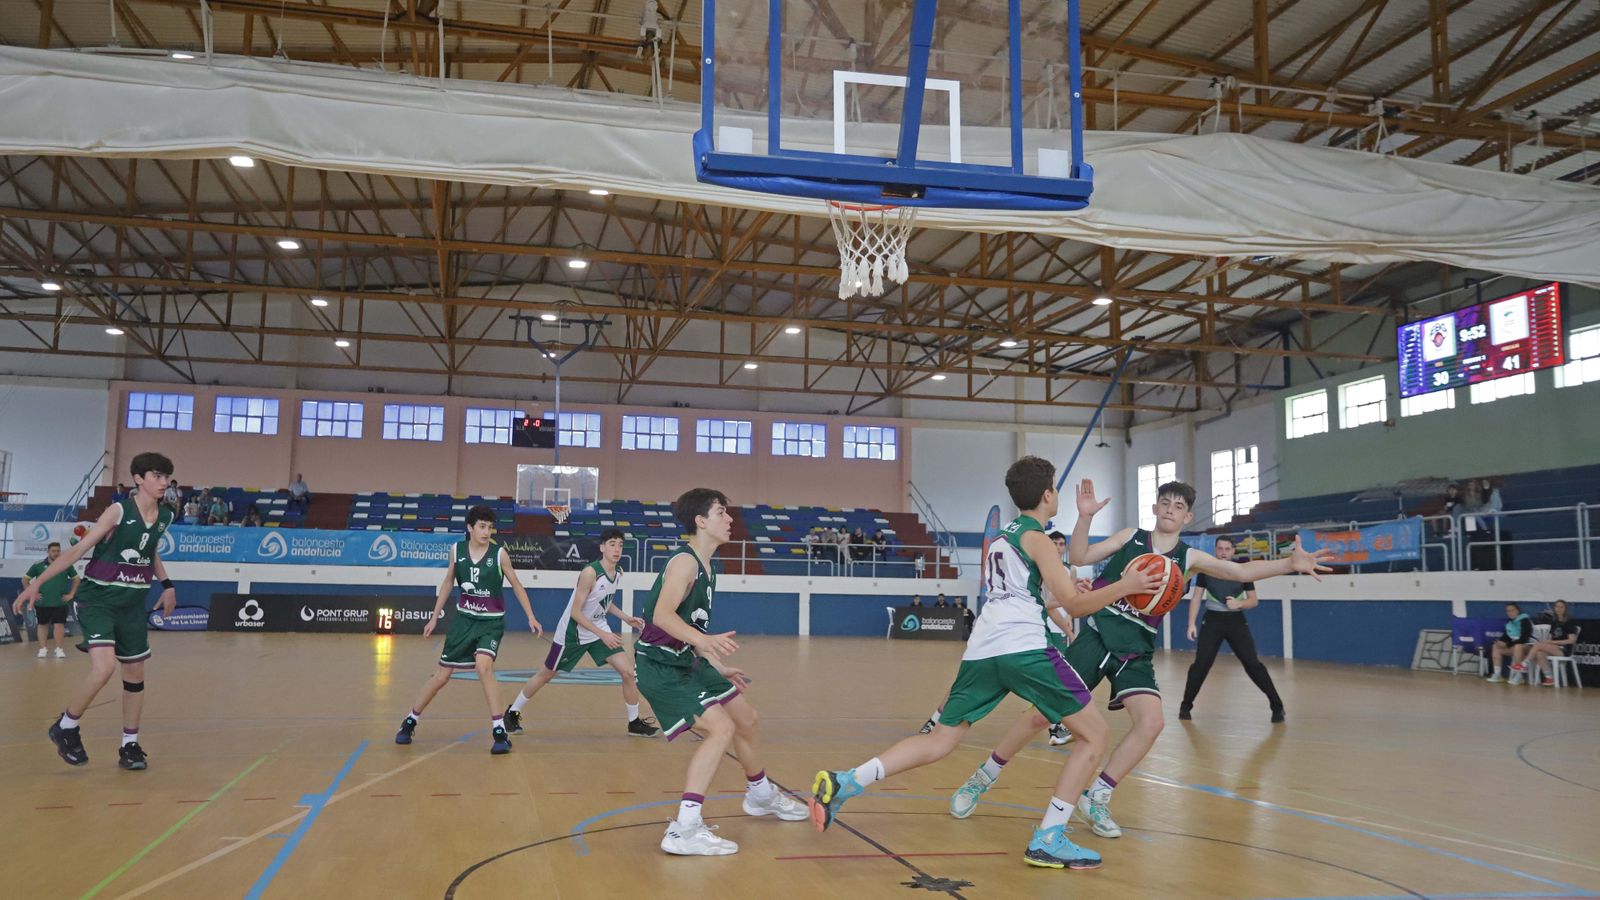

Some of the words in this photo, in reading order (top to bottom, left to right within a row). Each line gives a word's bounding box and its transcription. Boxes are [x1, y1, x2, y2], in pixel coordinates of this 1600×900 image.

[1460, 324, 1487, 342] 9:52
[1502, 354, 1520, 370] 41
[1432, 371, 1449, 386] 30
[139, 532, 149, 550] 8
[180, 532, 235, 545] baloncesto
[291, 536, 345, 548] baloncesto
[469, 566, 480, 583] 12
[988, 551, 1006, 592] 15
[316, 609, 342, 617] PONT
[343, 609, 369, 617] GRUP
[379, 616, 391, 629] 16
